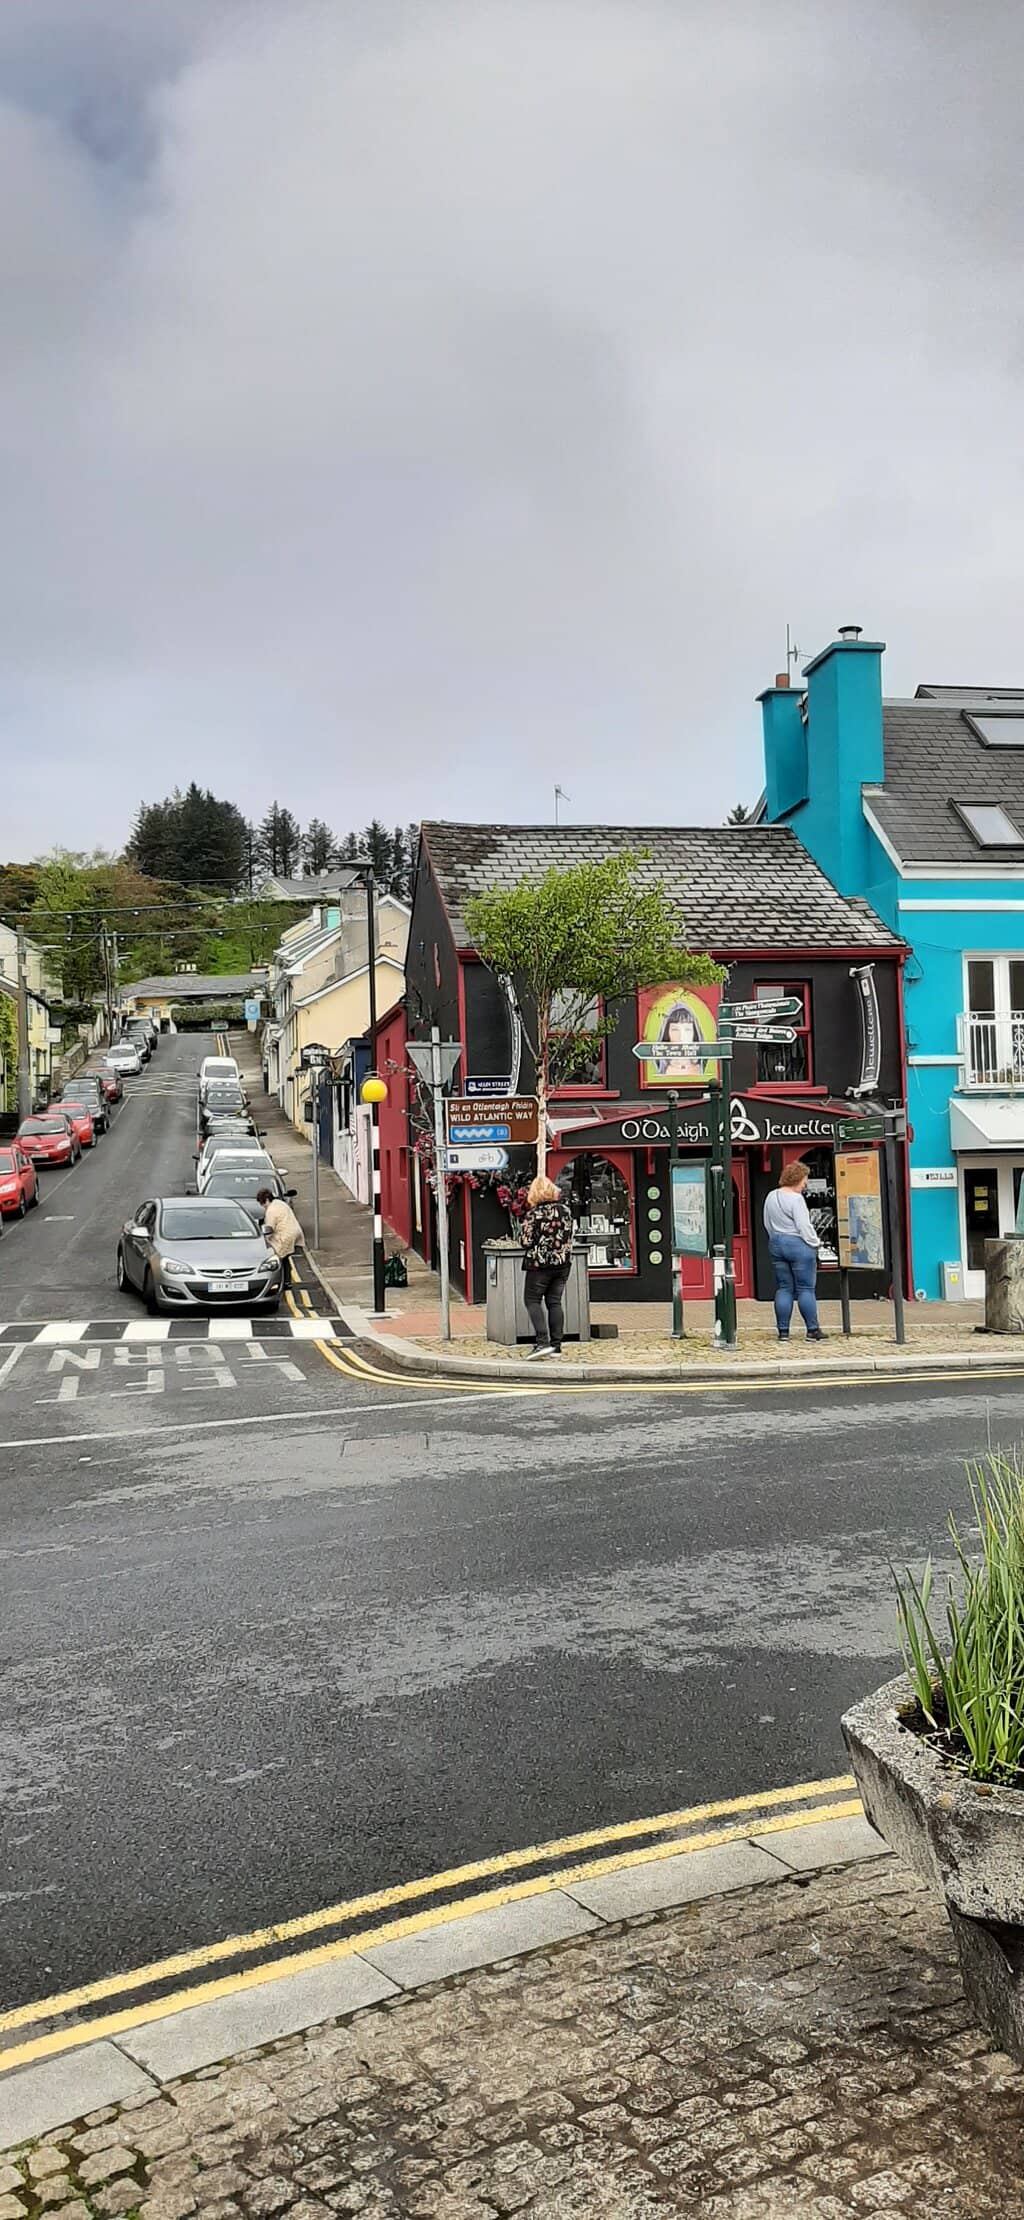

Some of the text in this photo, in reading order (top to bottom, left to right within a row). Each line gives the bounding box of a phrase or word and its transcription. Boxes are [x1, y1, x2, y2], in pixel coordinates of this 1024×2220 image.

[450, 1111, 534, 1122] WILD ATLANTIC WAY
[621, 1119, 709, 1142] O'Daaigh
[763, 1118, 834, 1140] Jewelle
[47, 1342, 290, 1372] TURN
[33, 1361, 307, 1405] LEFT
